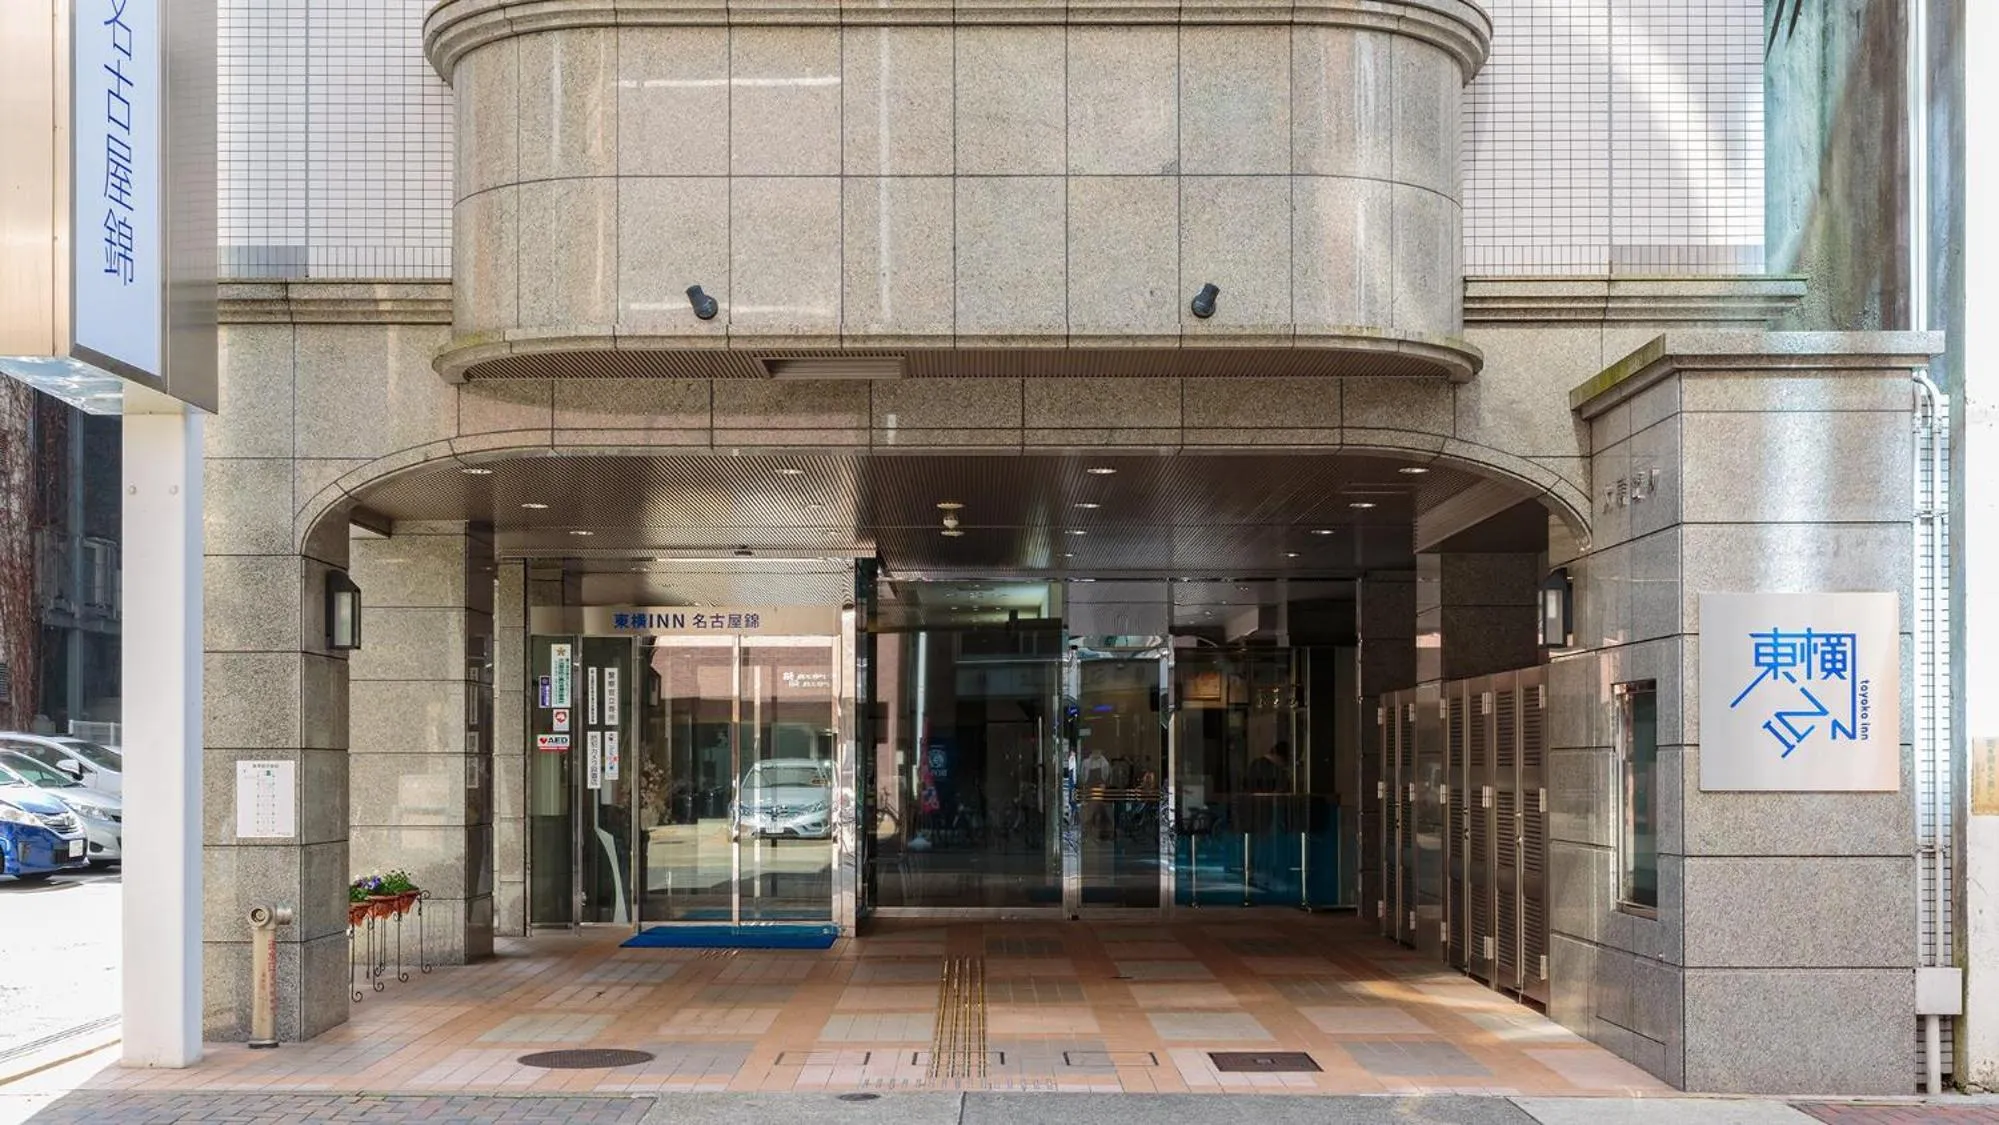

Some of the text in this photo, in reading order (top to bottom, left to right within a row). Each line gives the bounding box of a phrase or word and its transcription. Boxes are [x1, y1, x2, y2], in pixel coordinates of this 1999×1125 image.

[614, 613, 759, 629] 東横INN 名古屋錦
[1859, 679, 1870, 740] toyoko inn
[548, 736, 568, 745] AED
